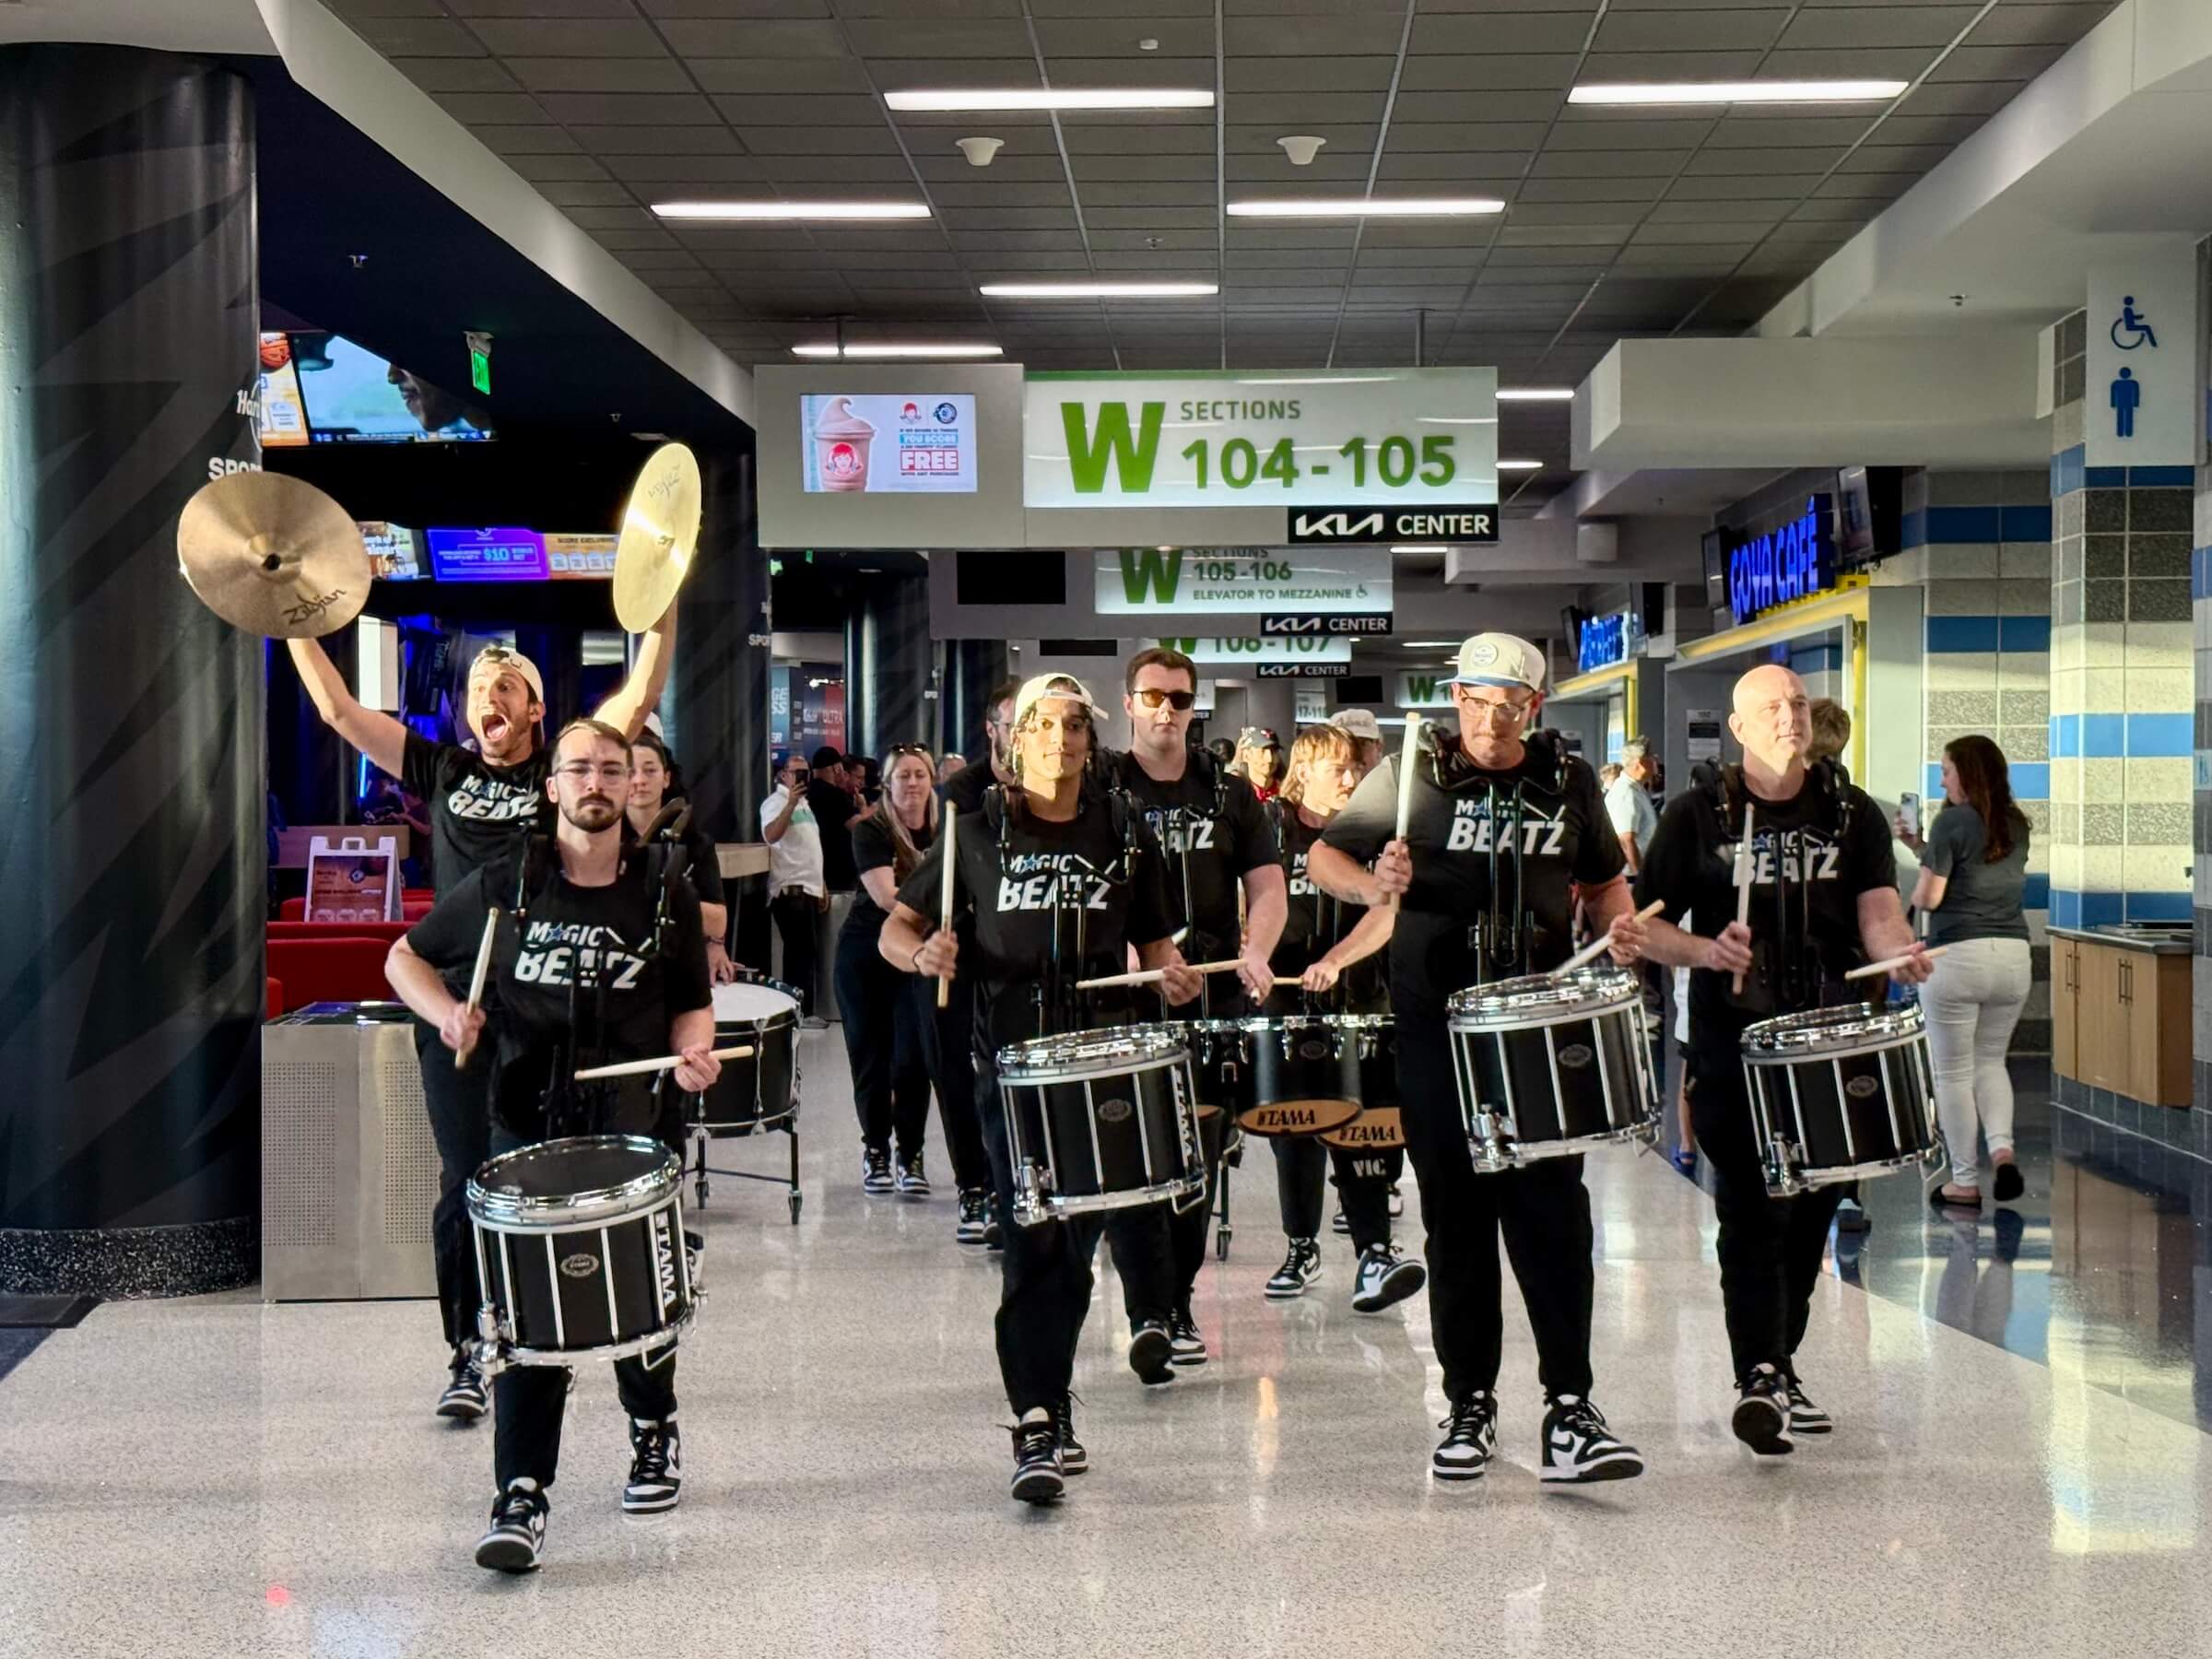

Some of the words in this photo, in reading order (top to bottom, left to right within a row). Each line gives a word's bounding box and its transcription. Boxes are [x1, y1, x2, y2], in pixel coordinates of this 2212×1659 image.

[1180, 400, 1301, 420] SECTIONS
[1060, 402, 1166, 494] W
[900, 450, 959, 471] FREE
[1295, 513, 1383, 536] KIA
[1395, 513, 1490, 536] CENTER
[1118, 547, 1184, 605] W
[1730, 534, 1773, 626] GOYA
[1193, 589, 1254, 601] ELEVATOR
[1258, 589, 1276, 600] TO
[1278, 588, 1352, 600] MEZZANINE
[1265, 617, 1322, 632] KIA
[1328, 617, 1388, 632] CENTER
[1260, 665, 1300, 676] KIA
[1304, 665, 1347, 676] CENTER
[1407, 677, 1437, 702] W
[448, 790, 540, 820] BEATZ
[1446, 817, 1566, 855] BEATZ
[1732, 845, 1841, 887] BEATZ
[1263, 1109, 1317, 1126] TAMA
[1348, 1125, 1397, 1142] TAMA
[656, 1226, 678, 1309] TAMA
